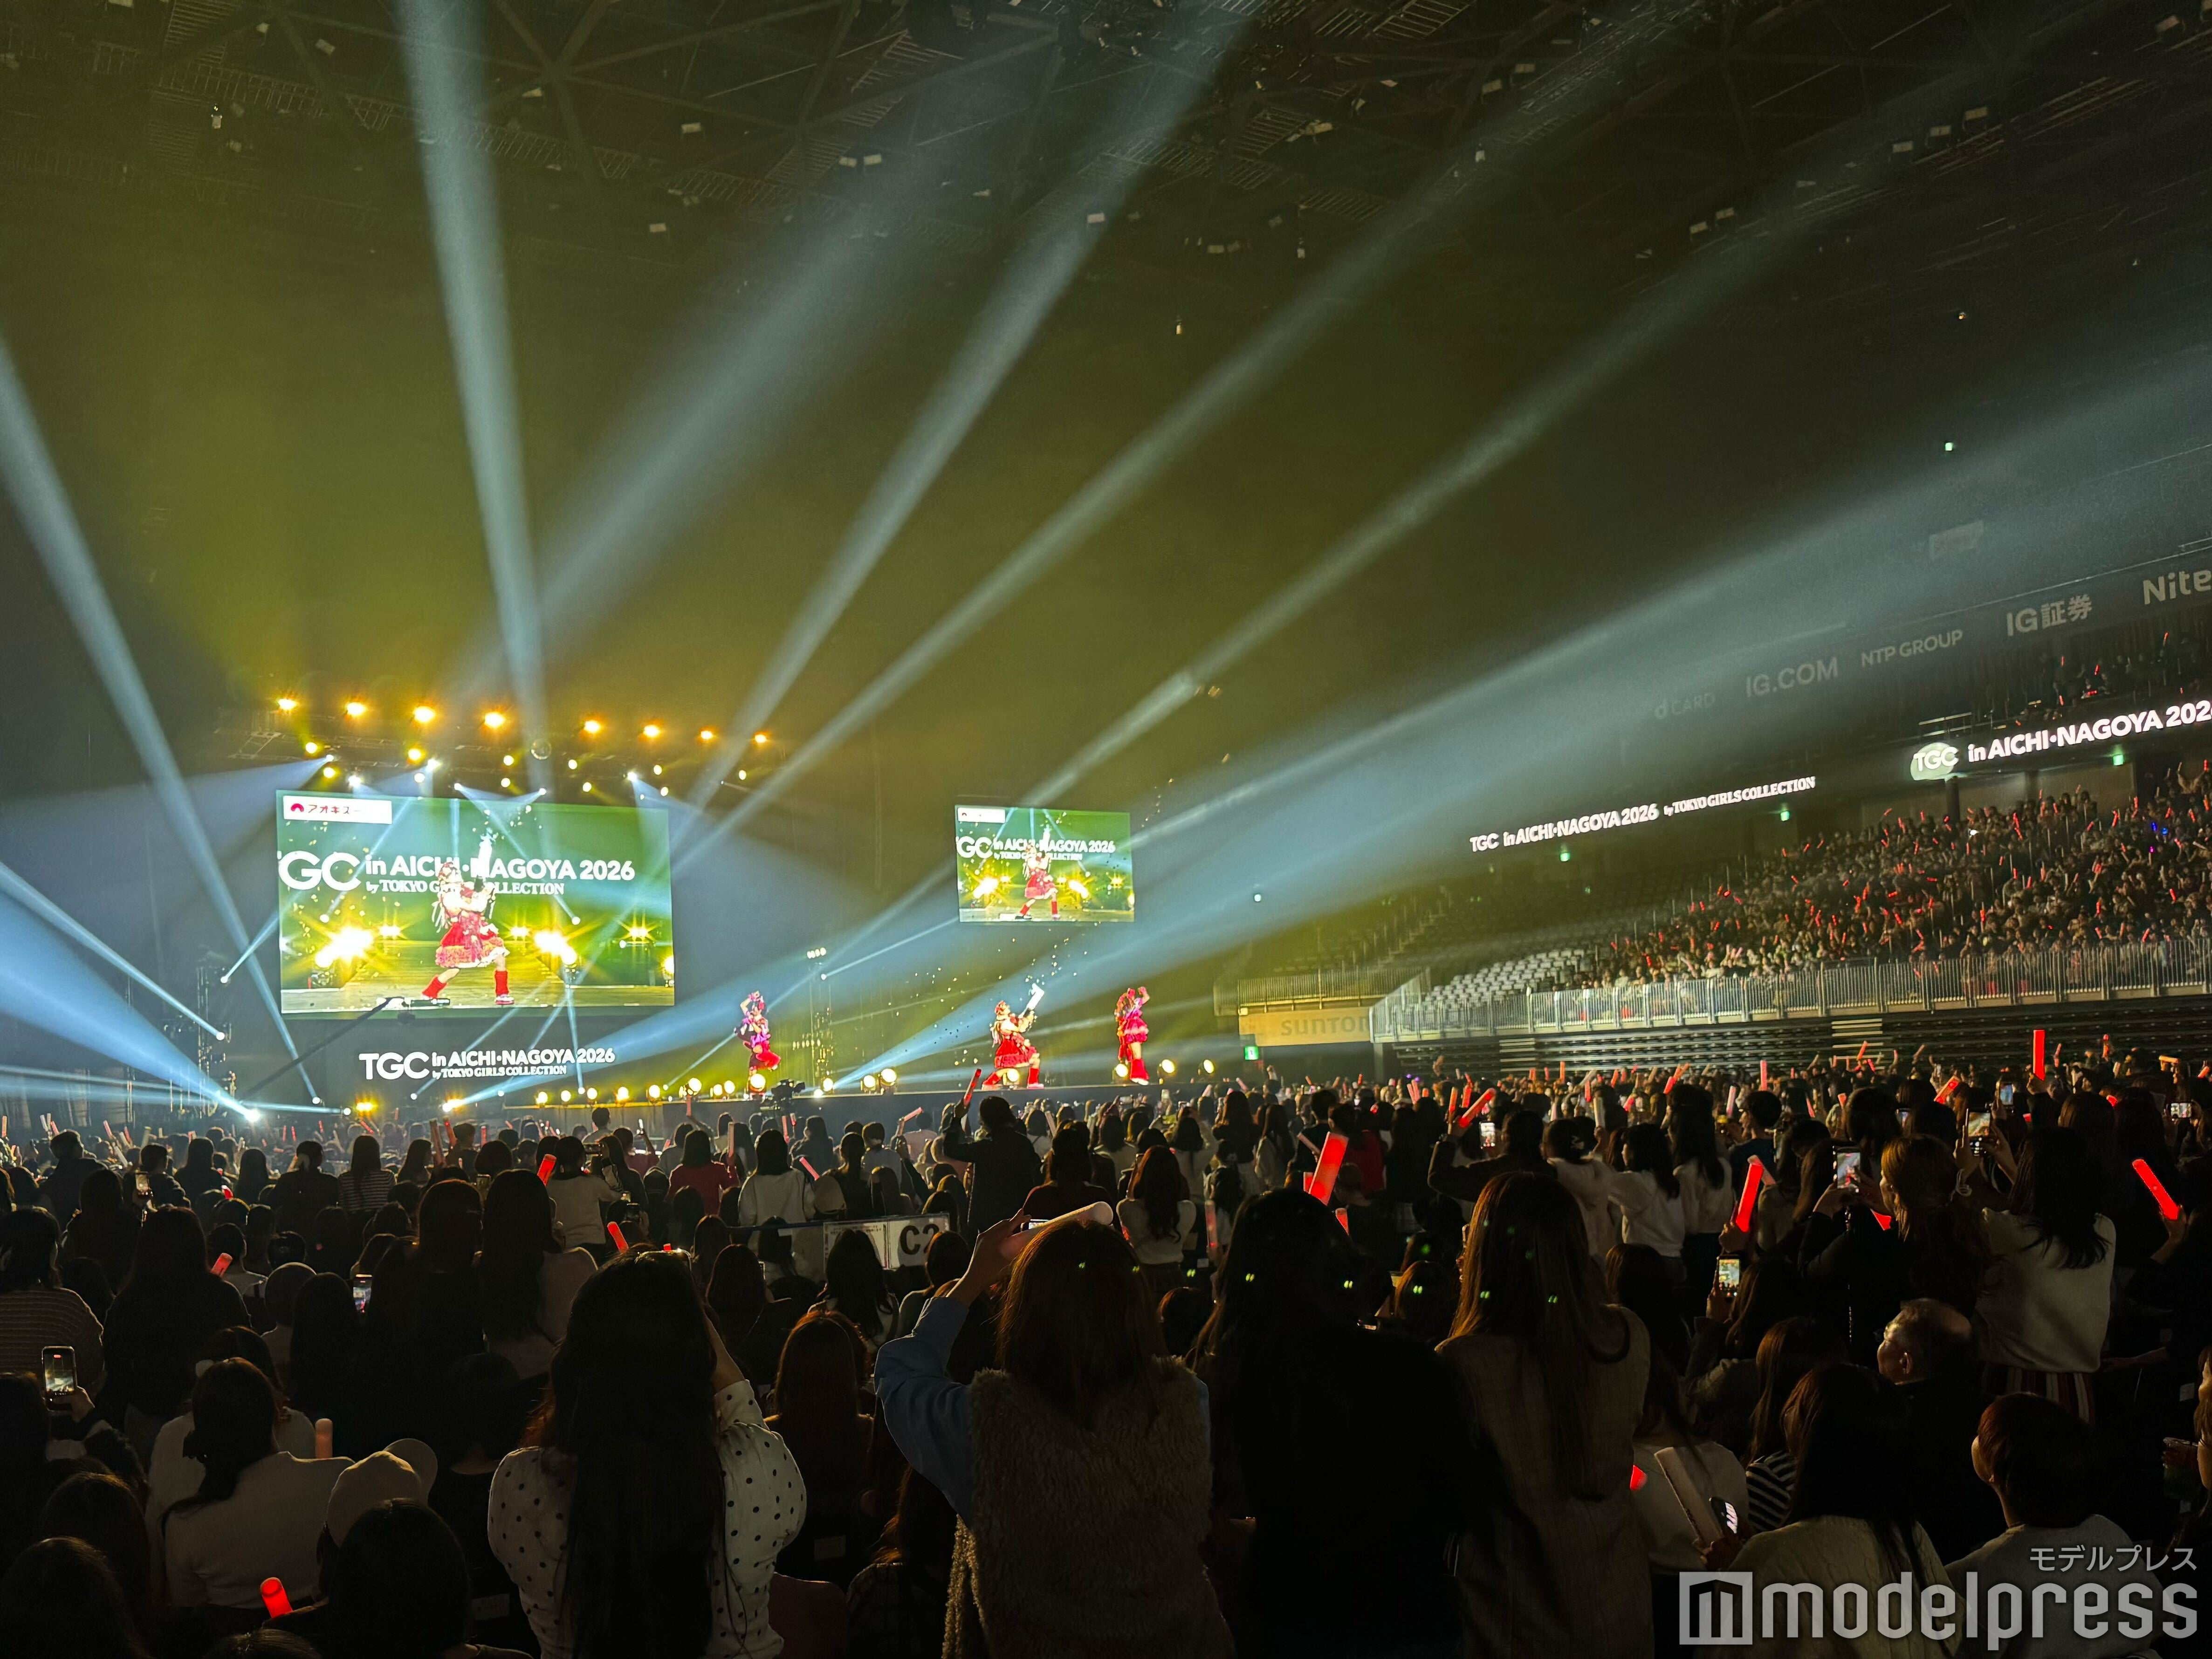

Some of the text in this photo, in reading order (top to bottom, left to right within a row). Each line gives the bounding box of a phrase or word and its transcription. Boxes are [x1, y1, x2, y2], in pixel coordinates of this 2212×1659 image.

[2006, 594, 2092, 637] IG証券
[1862, 630, 1964, 667] NTP GROUP
[1745, 657, 1838, 698] IG.COM
[1913, 747, 1958, 771] TGC
[1968, 744, 1986, 762] in
[2165, 700, 2212, 727] 202
[1672, 796, 1707, 813] TOKYO
[1707, 789, 1742, 807] GIRLS
[1742, 776, 1816, 801] COLLECTION
[1470, 833, 1499, 852] TGC
[1503, 831, 1516, 846] in
[1621, 803, 1659, 825] 2026
[956, 836, 993, 858] GC
[1088, 840, 1116, 853] 2026
[277, 850, 361, 891] GC
[365, 854, 386, 875] in
[579, 859, 635, 880] 2026
[379, 880, 428, 893] TOKYO
[359, 1051, 430, 1080] TGC
[432, 1052, 447, 1067] in
[576, 1048, 615, 1063] 2026
[441, 1067, 474, 1078] TOKYO
[474, 1066, 505, 1077] GIRLS
[505, 1065, 567, 1076] COLLECTION
[900, 1223, 940, 1255] C2
